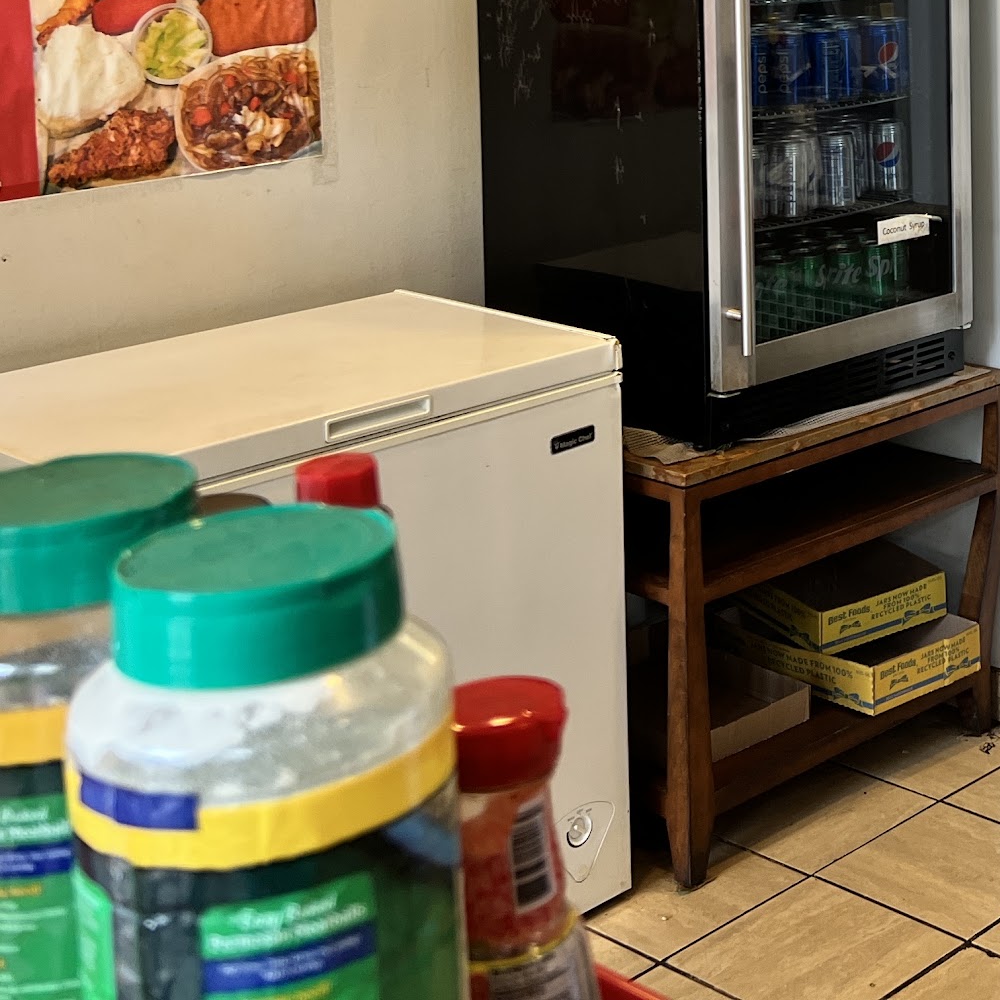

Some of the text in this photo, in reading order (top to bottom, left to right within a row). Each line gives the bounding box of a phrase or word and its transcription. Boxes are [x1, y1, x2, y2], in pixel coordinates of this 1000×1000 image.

[882, 220, 925, 236] Coconut Syrup
[909, 583, 927, 595] MADE
[828, 605, 871, 626] Best Foods
[871, 594, 931, 620] RECYCLED PLASTIC
[951, 637, 966, 648] MADE
[787, 652, 809, 665] MADE
[809, 657, 832, 671] FROM
[880, 658, 917, 680] Best Foods
[806, 668, 837, 685] PLASTIC
